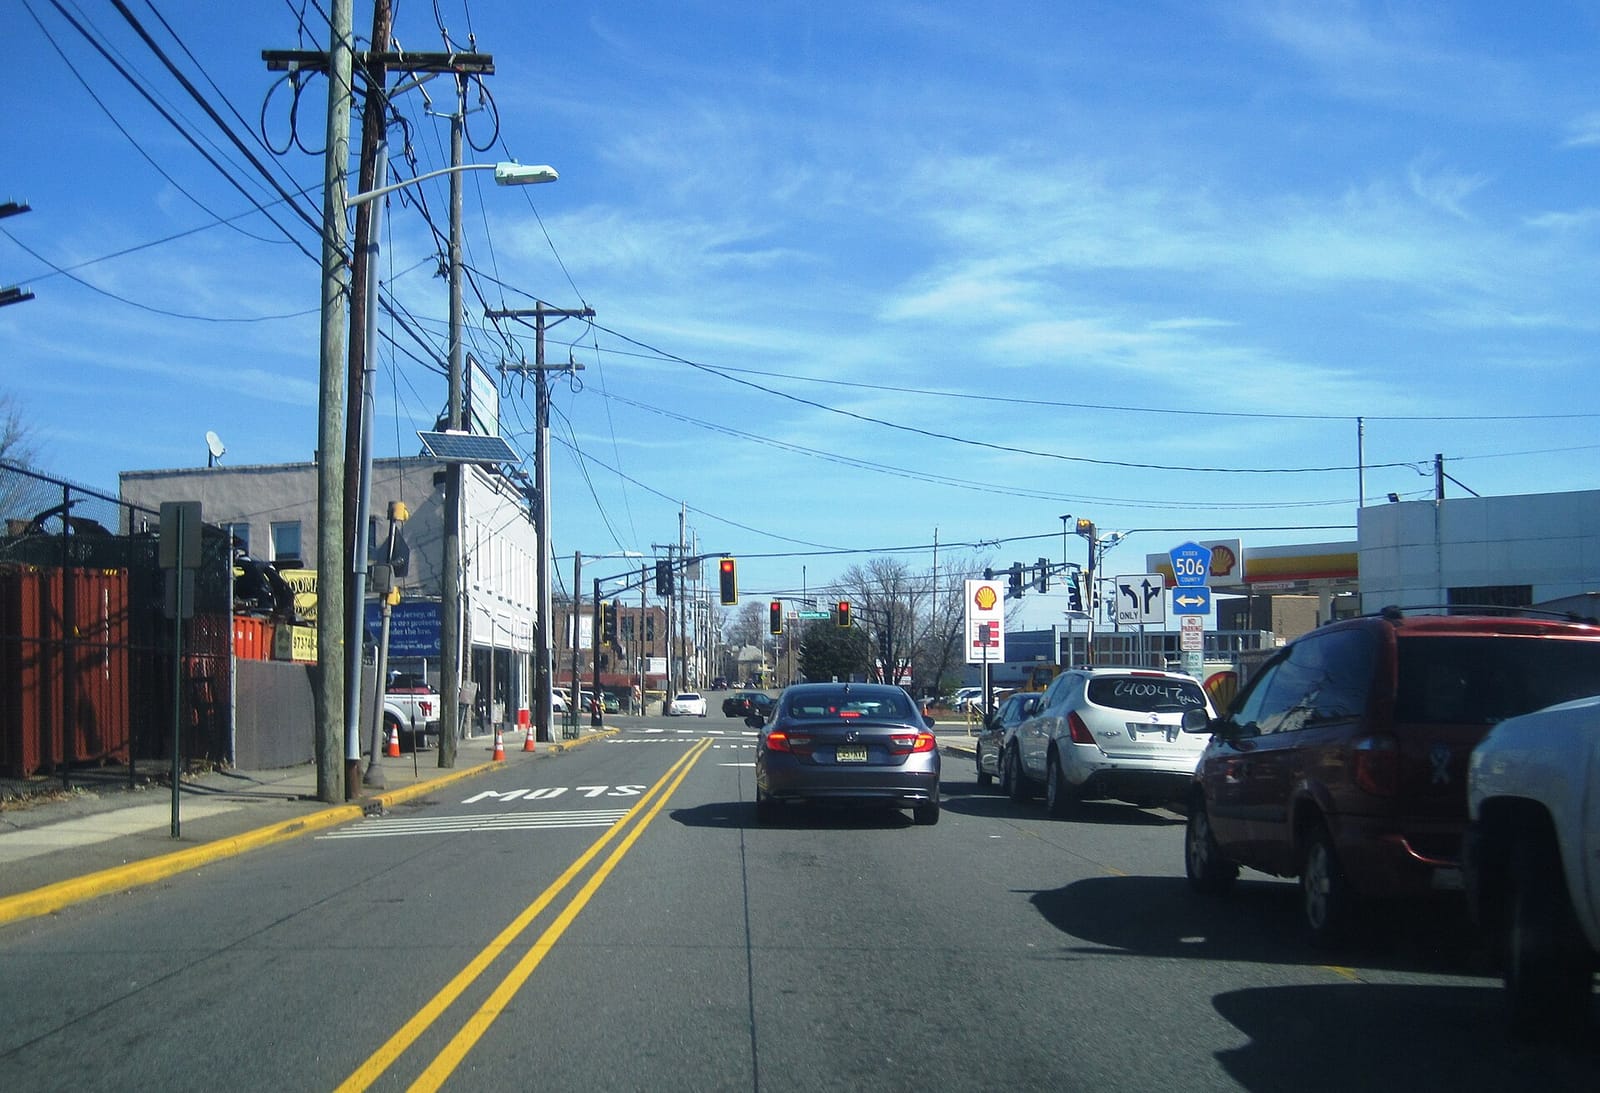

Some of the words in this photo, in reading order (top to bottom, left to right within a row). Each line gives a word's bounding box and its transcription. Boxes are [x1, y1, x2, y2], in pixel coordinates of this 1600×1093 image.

[1176, 558, 1205, 576] 506
[1119, 611, 1139, 620] ONLY
[461, 785, 647, 804] SLOW
